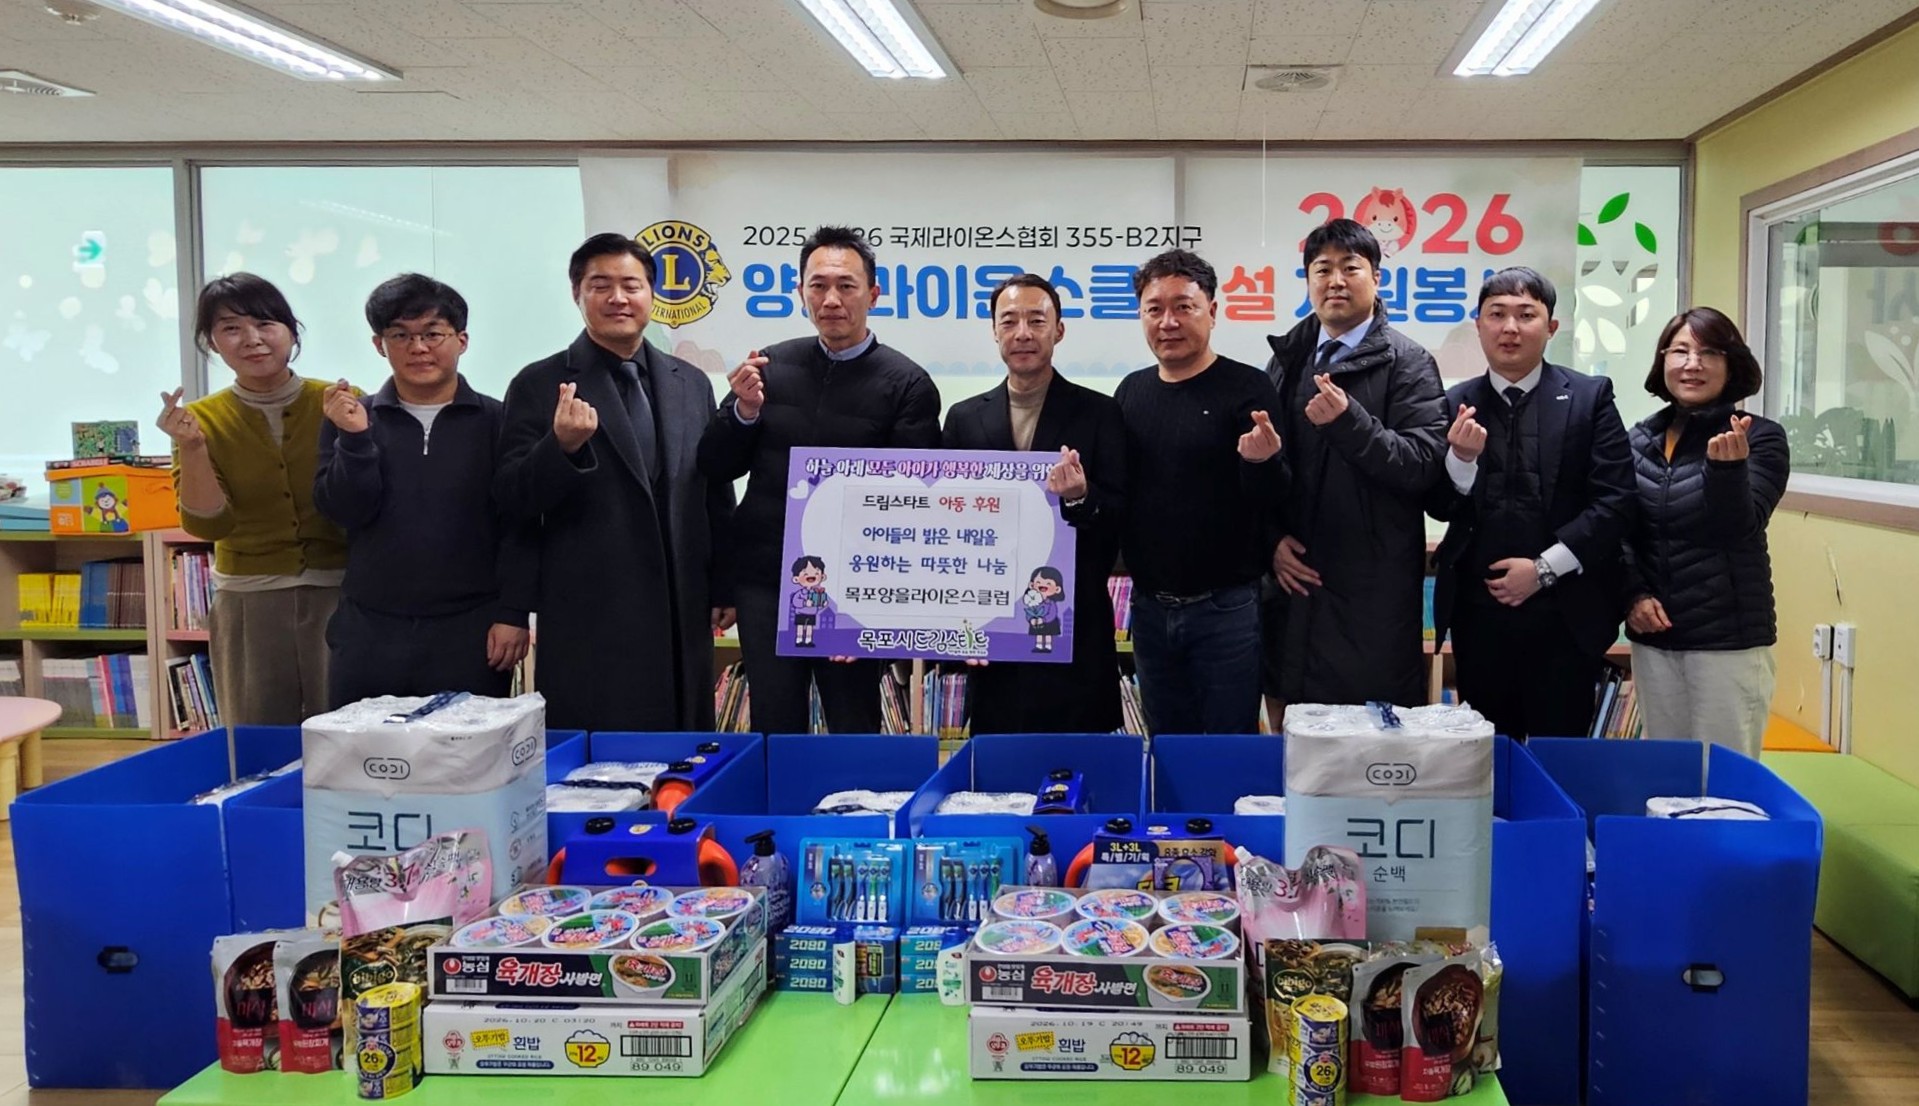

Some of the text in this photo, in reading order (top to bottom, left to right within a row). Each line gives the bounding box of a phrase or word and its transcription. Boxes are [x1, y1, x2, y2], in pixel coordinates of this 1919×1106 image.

[641, 225, 705, 248] LIONS
[890, 226, 1059, 248] 국제라이온스협회
[1066, 226, 1203, 249] 355-B2지구
[661, 254, 691, 291] L
[743, 264, 1140, 319] 양라이온스클
[1221, 265, 1276, 321] 설
[652, 301, 707, 320] TERNATIONAL
[805, 458, 834, 477] 하늘
[835, 459, 867, 477] 아래
[867, 460, 897, 478] 모든
[898, 460, 941, 479] 아이가
[942, 460, 986, 480] 행복한
[985, 461, 1029, 482] 세상을
[862, 495, 1001, 513] 드림스타트 아동 후원
[862, 527, 998, 547] 아이들의 밝은 내일을
[849, 554, 1008, 575] 응원하는 따뜻한 나눔
[845, 587, 1010, 606] 목포양을라이온스클럽
[347, 811, 432, 851] 코디
[1347, 818, 1436, 859] 코디
[1109, 842, 1142, 853] 3L+3L
[1373, 865, 1406, 883] 순백
[783, 925, 837, 935] 2080
[789, 939, 828, 951] 2080
[915, 940, 943, 951] 208
[462, 960, 490, 973] 농심
[496, 957, 562, 987] 육개장
[789, 958, 827, 970] 2080
[789, 977, 827, 988] 2080
[997, 967, 1026, 981] 농심
[1031, 965, 1096, 996] 육개장
[513, 1036, 541, 1051] 흰밥
[1058, 1038, 1086, 1053] 흰밥
[577, 1045, 597, 1063] 12
[1121, 1047, 1141, 1065] 12
[631, 1062, 682, 1072] 89 049
[1176, 1065, 1225, 1074] 89 049
